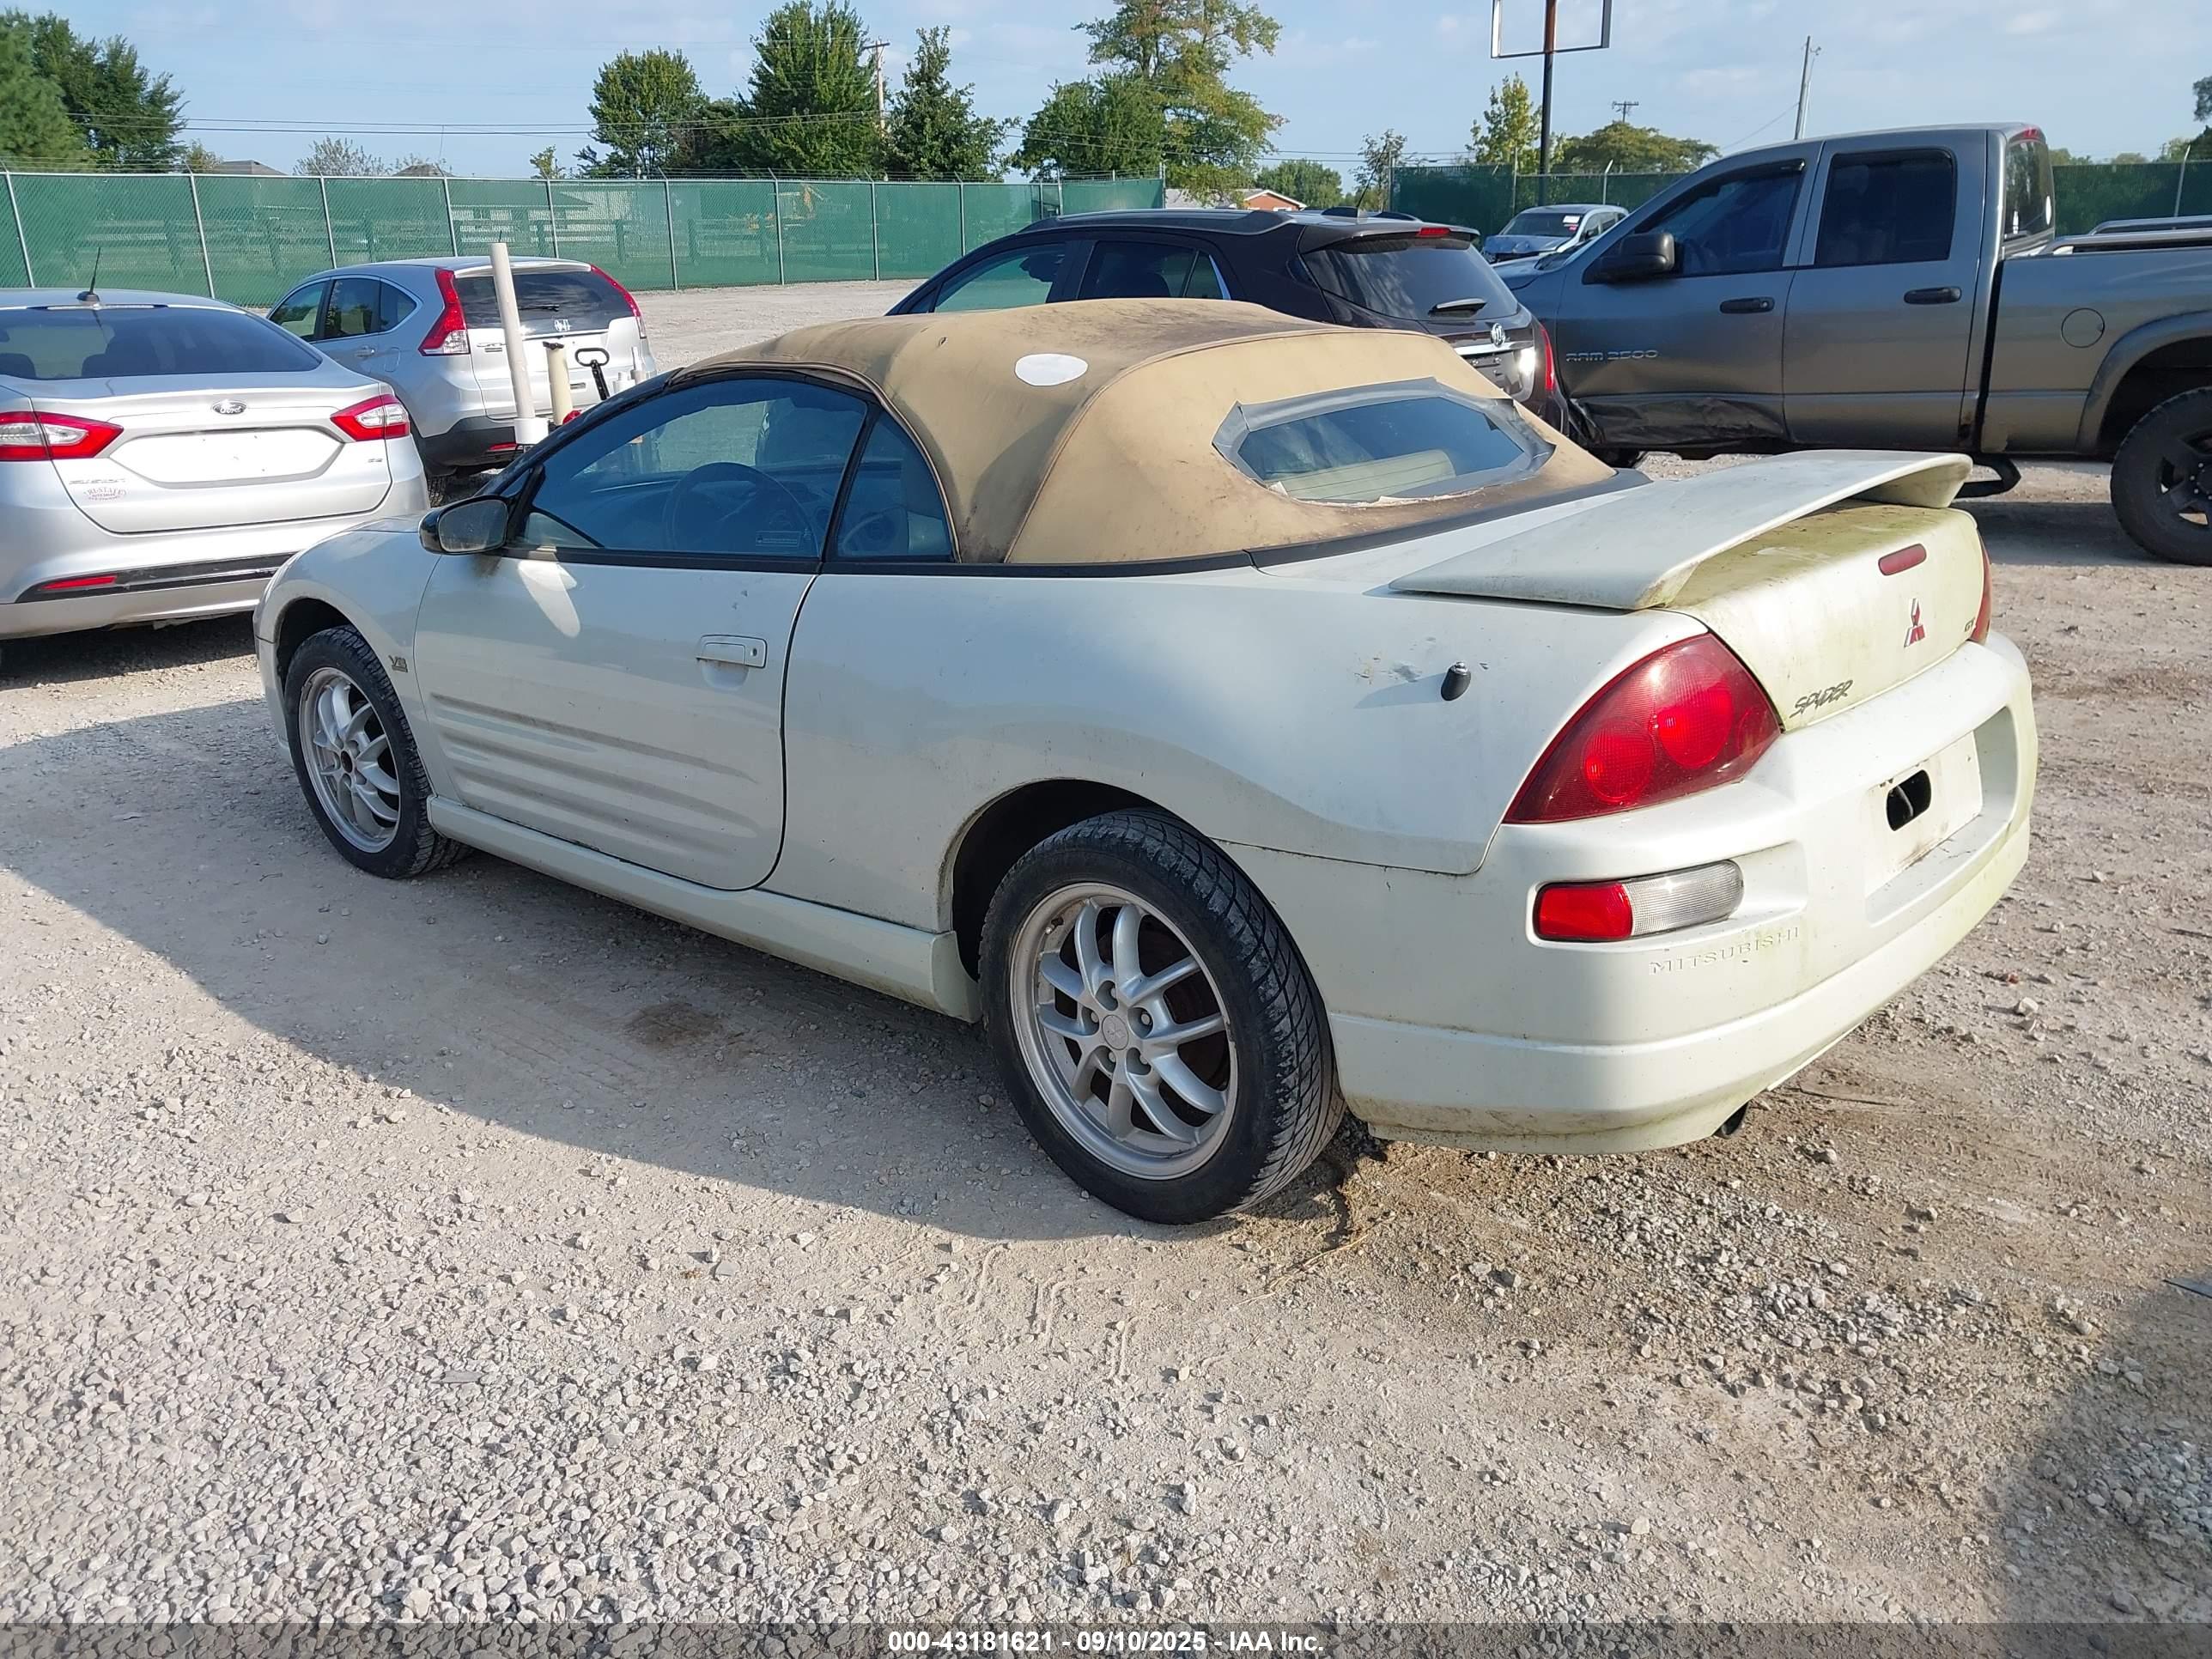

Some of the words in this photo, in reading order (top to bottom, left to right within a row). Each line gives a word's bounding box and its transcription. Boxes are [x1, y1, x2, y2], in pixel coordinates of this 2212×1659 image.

[1565, 352, 1603, 362] RAM
[1607, 349, 1658, 361] 2500
[1789, 679, 1853, 718] SPYDER
[1649, 927, 1798, 974] MITSUBISHI
